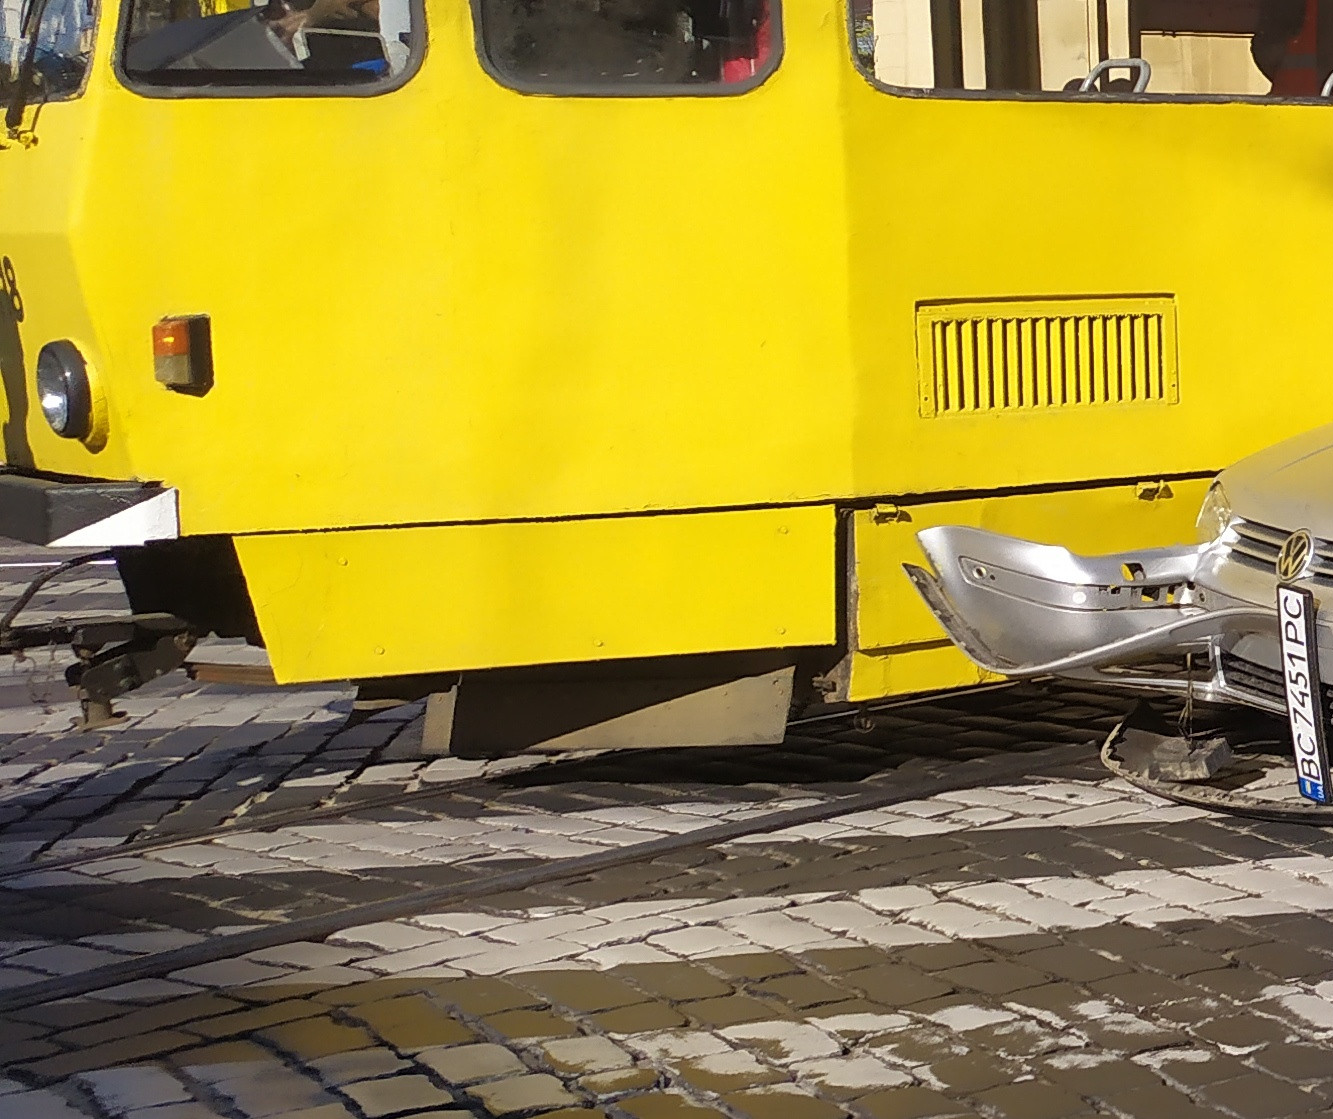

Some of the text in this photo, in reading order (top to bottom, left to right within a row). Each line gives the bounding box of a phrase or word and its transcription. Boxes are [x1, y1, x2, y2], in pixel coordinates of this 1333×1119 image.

[1283, 595, 1305, 647] PC
[1286, 652, 1313, 728] 7451
[1297, 733, 1321, 781] BC
